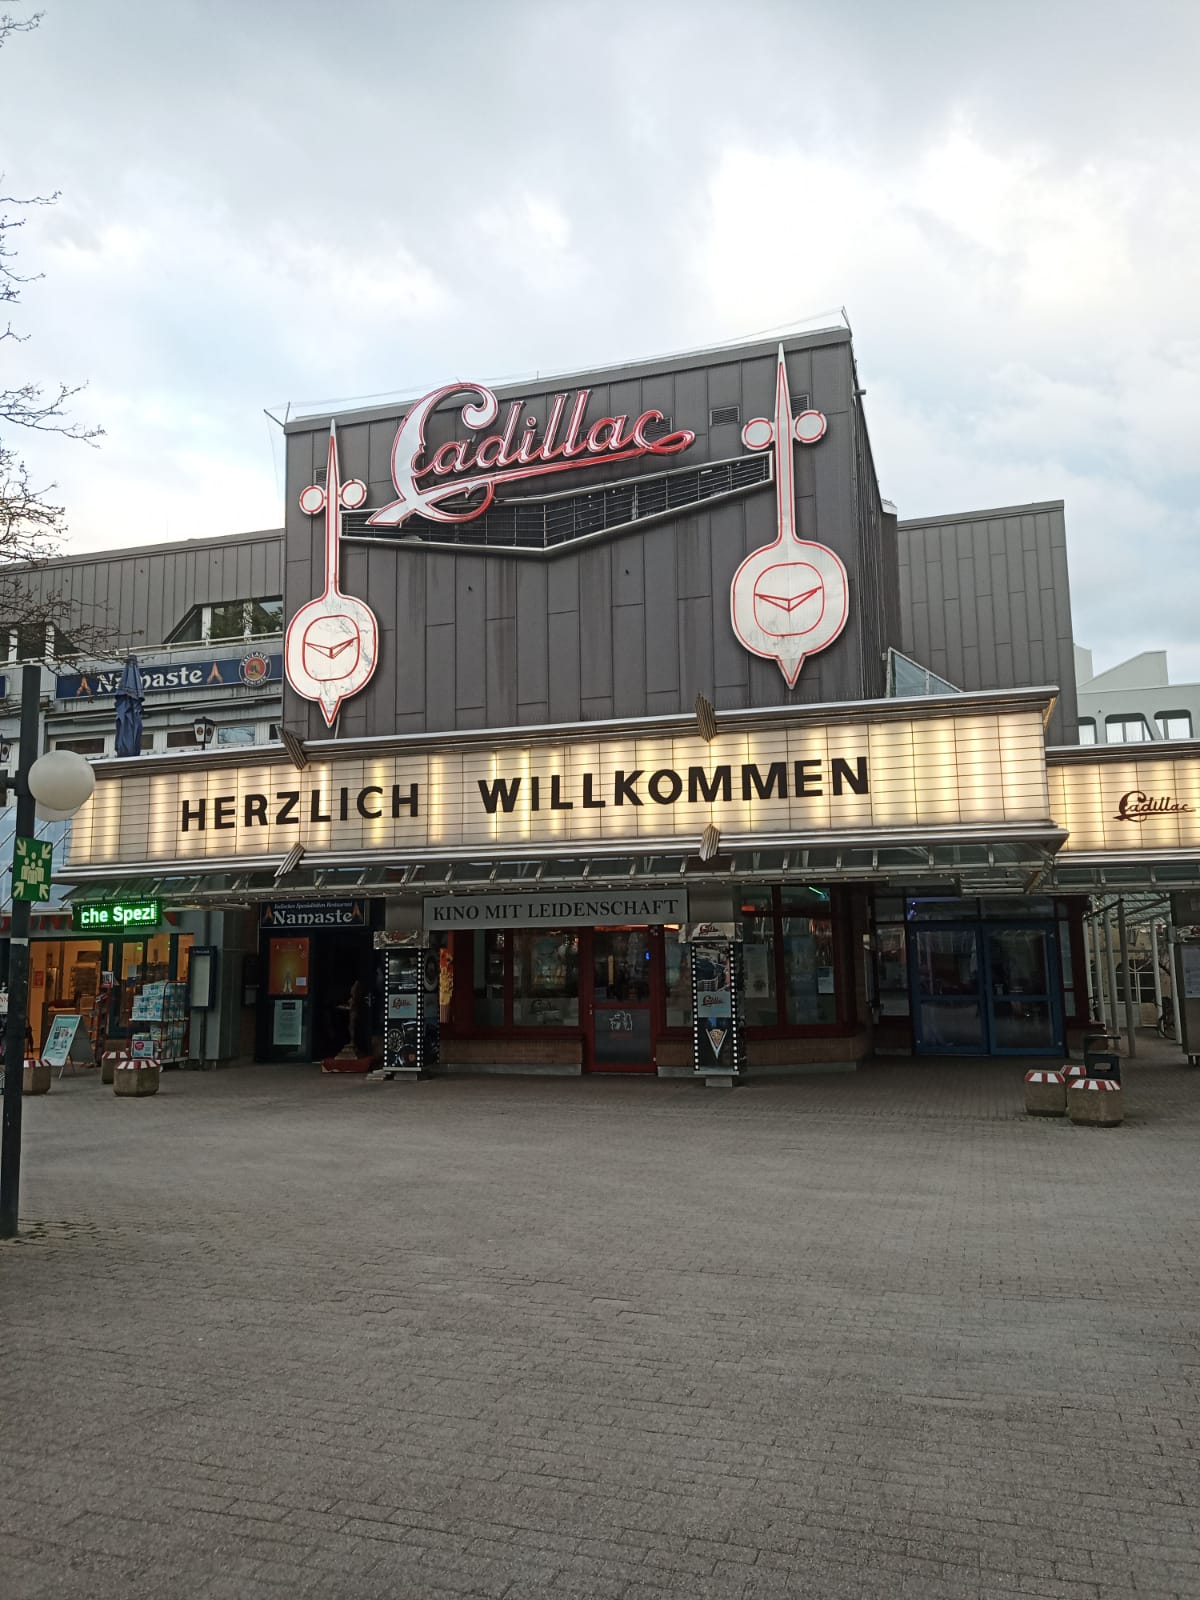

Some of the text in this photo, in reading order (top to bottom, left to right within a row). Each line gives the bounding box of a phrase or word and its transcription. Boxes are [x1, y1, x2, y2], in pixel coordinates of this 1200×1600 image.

[365, 382, 695, 526] Cadillac
[181, 756, 869, 832] HERZLICH WILLKOMMEN
[1113, 791, 1196, 822] Cadillac
[81, 908, 108, 924] che
[112, 904, 155, 925] Spezi
[273, 909, 353, 925] Namaste
[433, 899, 679, 921] KINO MIT LEIDENSCHAFT
